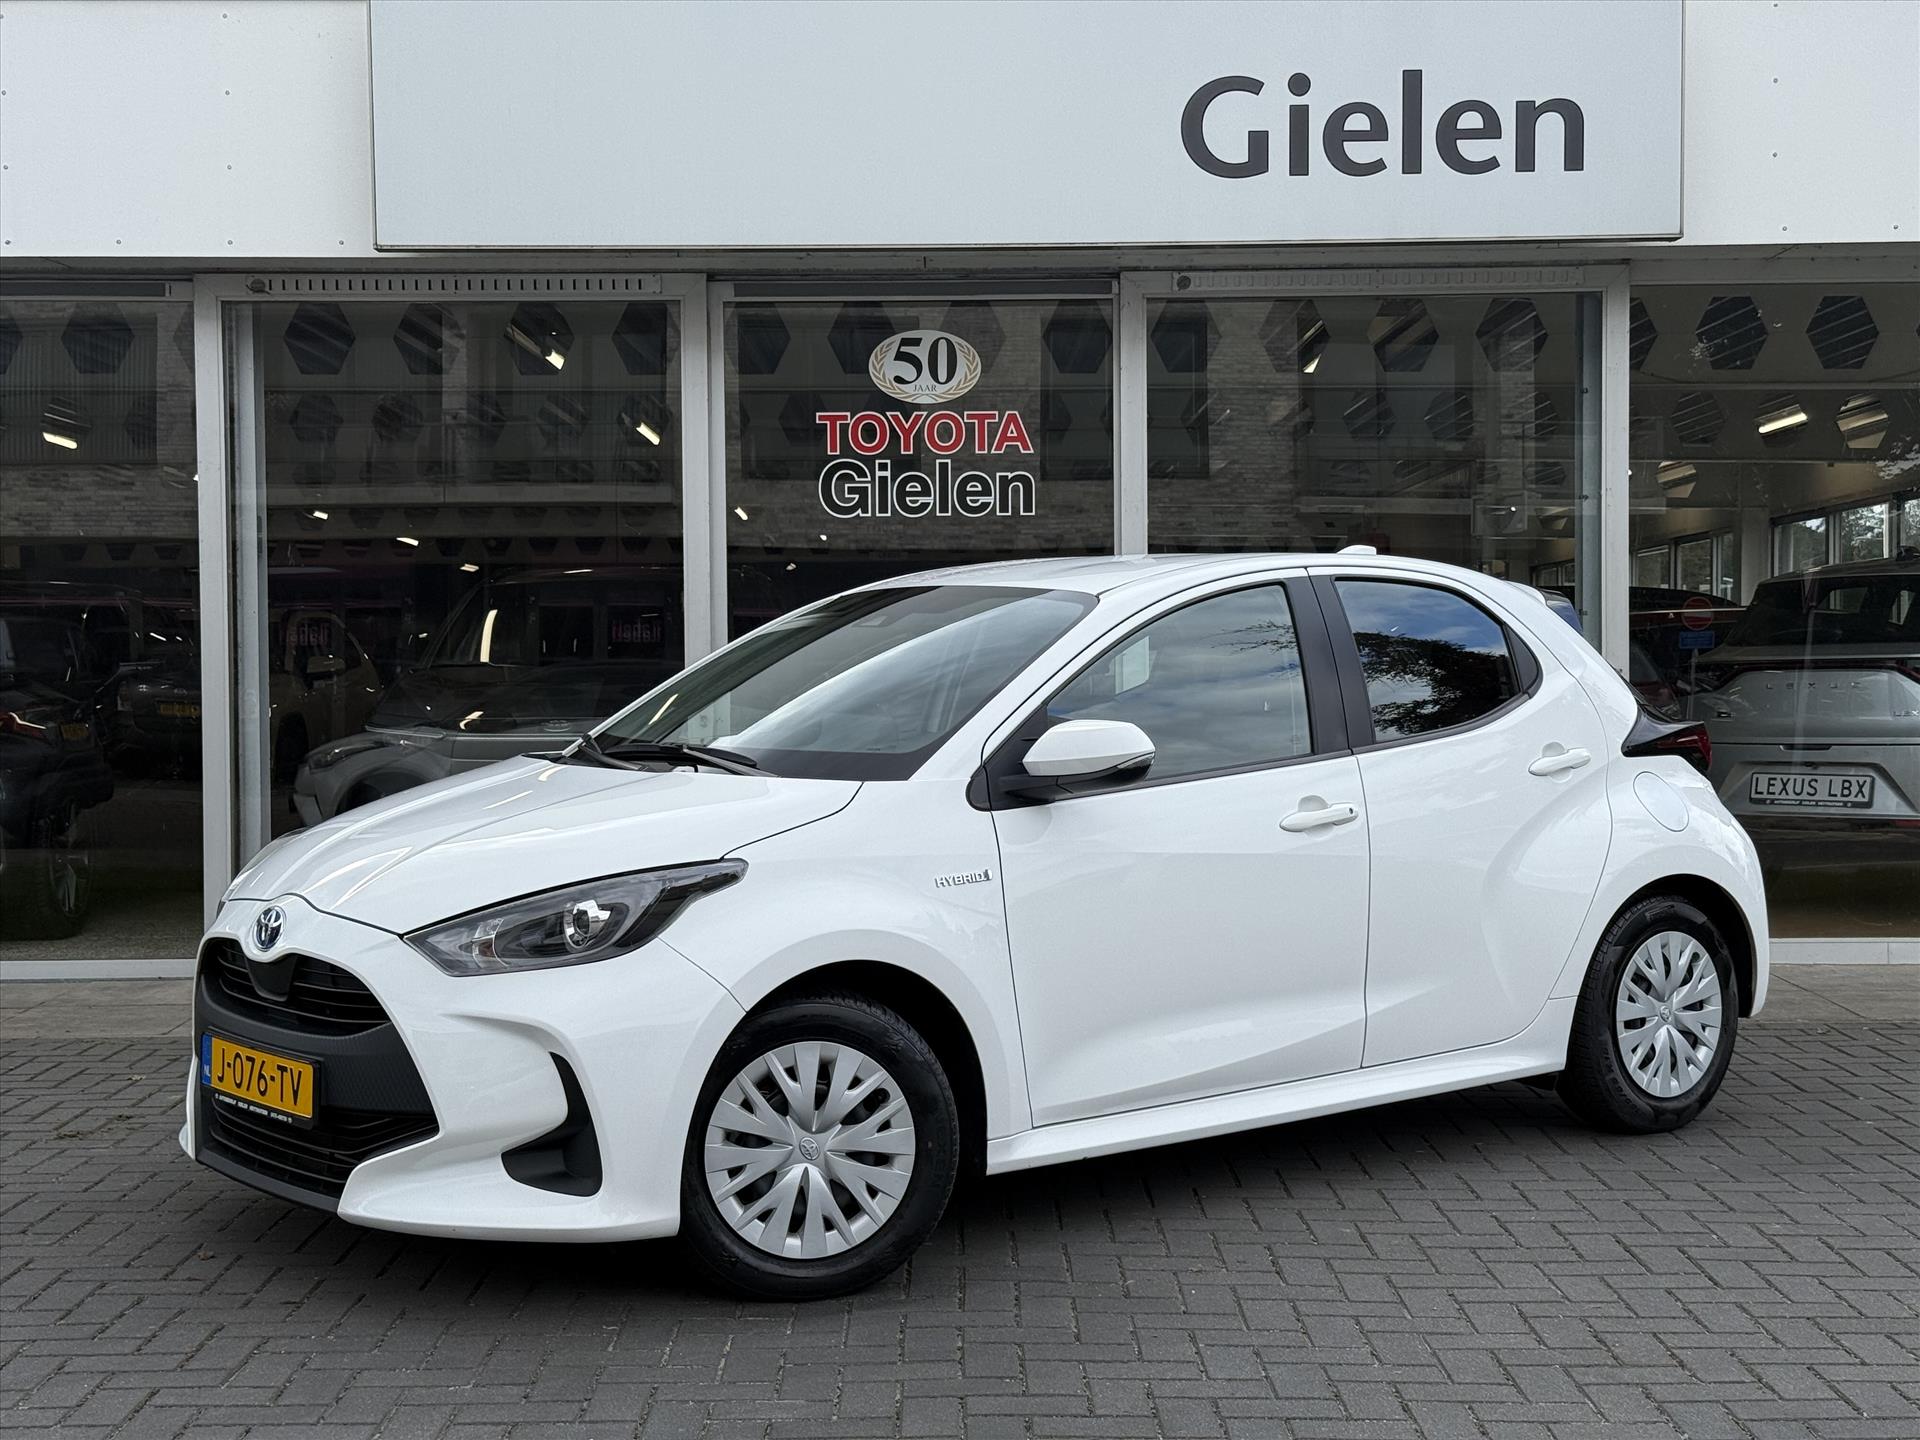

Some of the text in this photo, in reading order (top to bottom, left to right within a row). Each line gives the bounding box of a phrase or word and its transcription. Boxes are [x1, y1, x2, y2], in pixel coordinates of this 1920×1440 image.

[1181, 69, 1585, 179] Gielen
[893, 336, 958, 385] 50
[913, 384, 937, 392] JAAR
[815, 411, 1034, 455] TOYOTA
[818, 459, 1036, 518] Gielen
[1754, 776, 1867, 798] LEXUS LBX
[934, 871, 986, 888] HYBRID
[217, 1047, 303, 1107] J-076-TV
